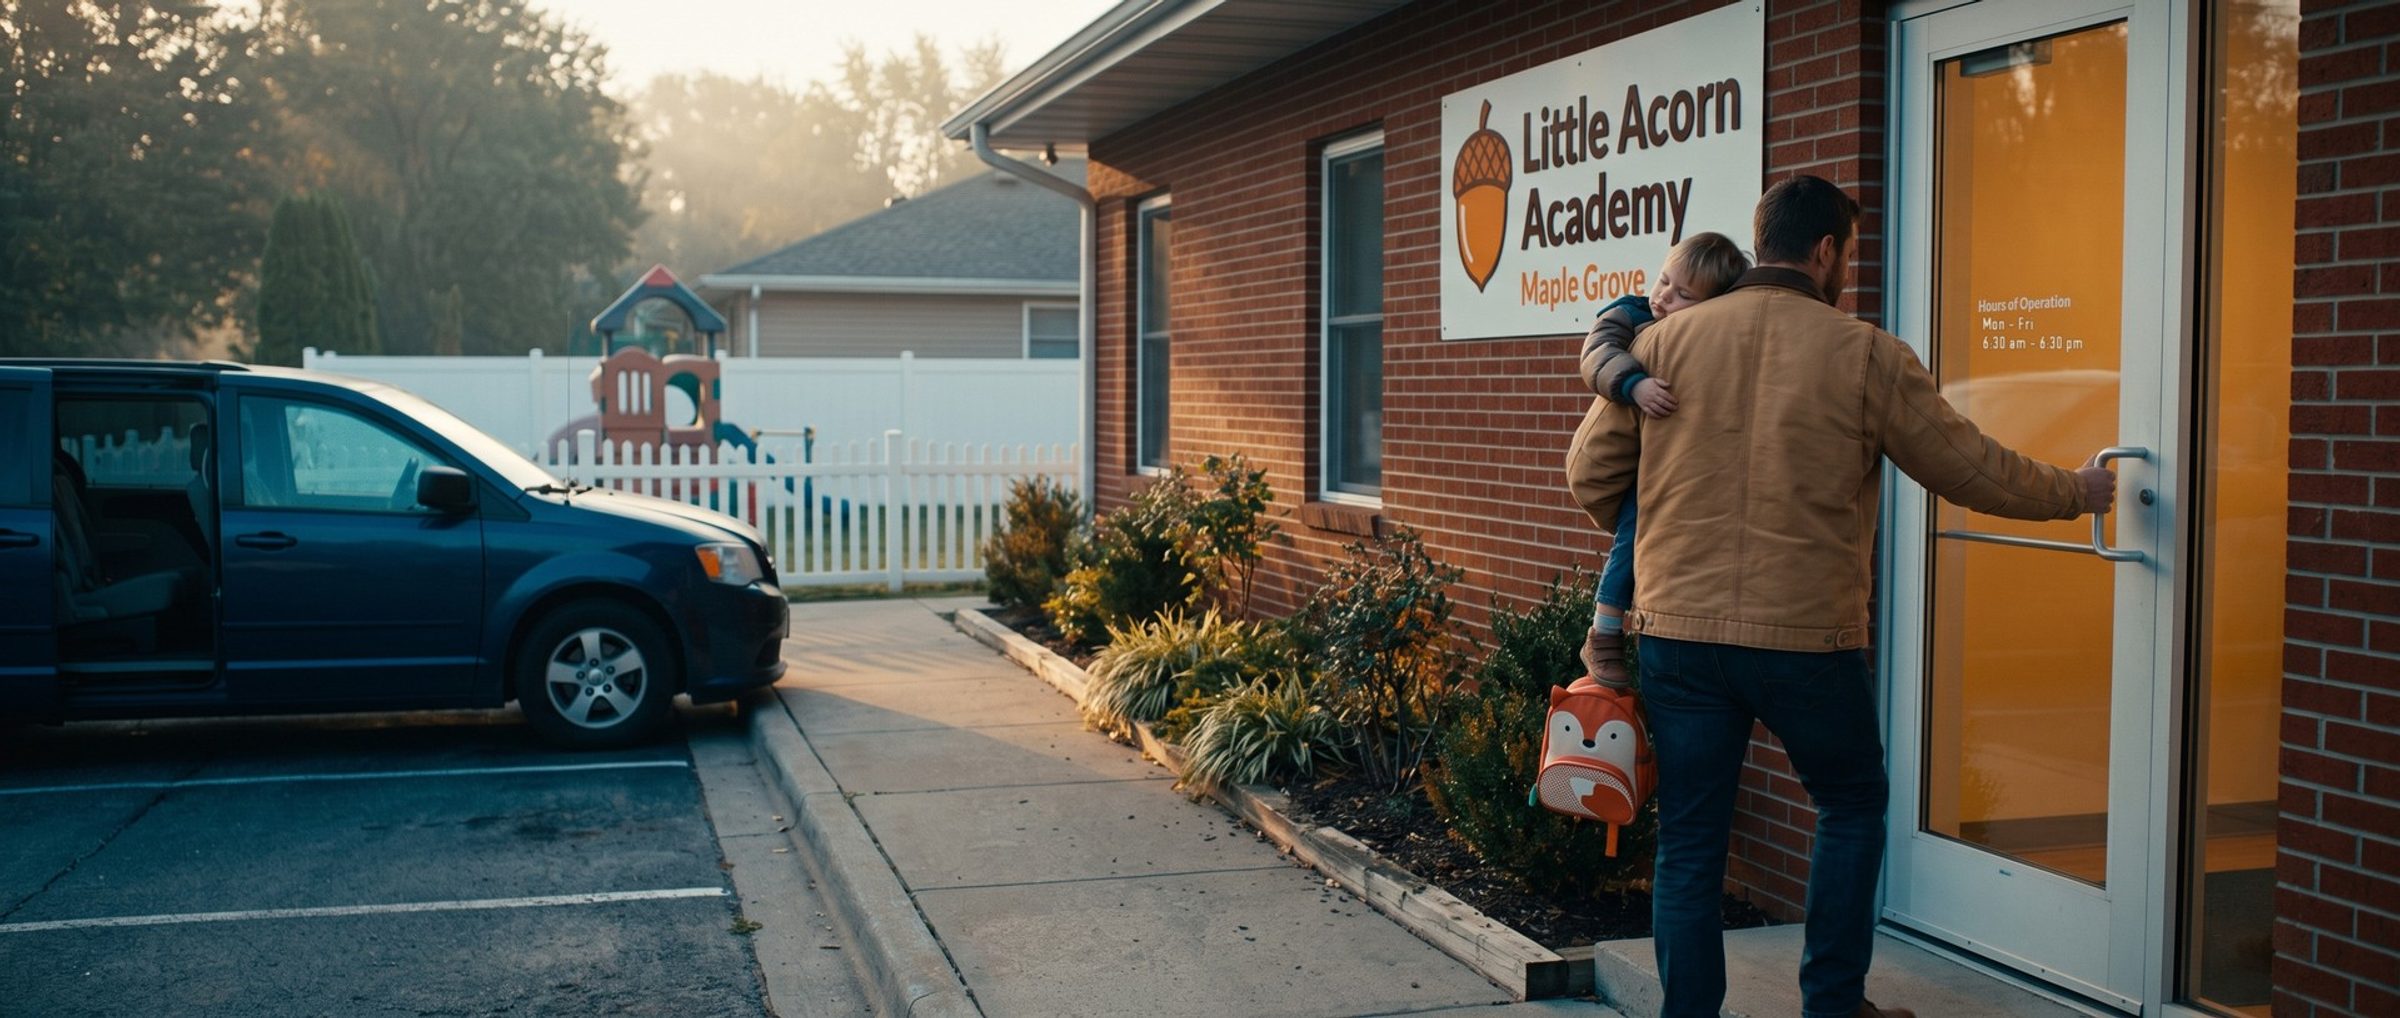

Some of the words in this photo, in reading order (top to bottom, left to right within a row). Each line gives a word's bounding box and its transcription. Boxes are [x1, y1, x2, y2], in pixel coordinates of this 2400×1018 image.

[1523, 95, 1609, 174] Little
[1617, 77, 1741, 155] Acorn
[1521, 171, 1693, 251] Academy
[1521, 265, 1578, 312] Maple
[1583, 263, 1646, 301] Grove
[1978, 299, 2006, 313] Hours
[2008, 297, 2018, 311] of
[2020, 295, 2071, 313] Operation
[1982, 317, 2005, 330] Mon
[2018, 317, 2034, 330] Fri
[1983, 336, 2006, 349] 6:30
[2009, 339, 2026, 349] am
[2040, 336, 2062, 349] 6:30
[2067, 339, 2083, 352] pm
